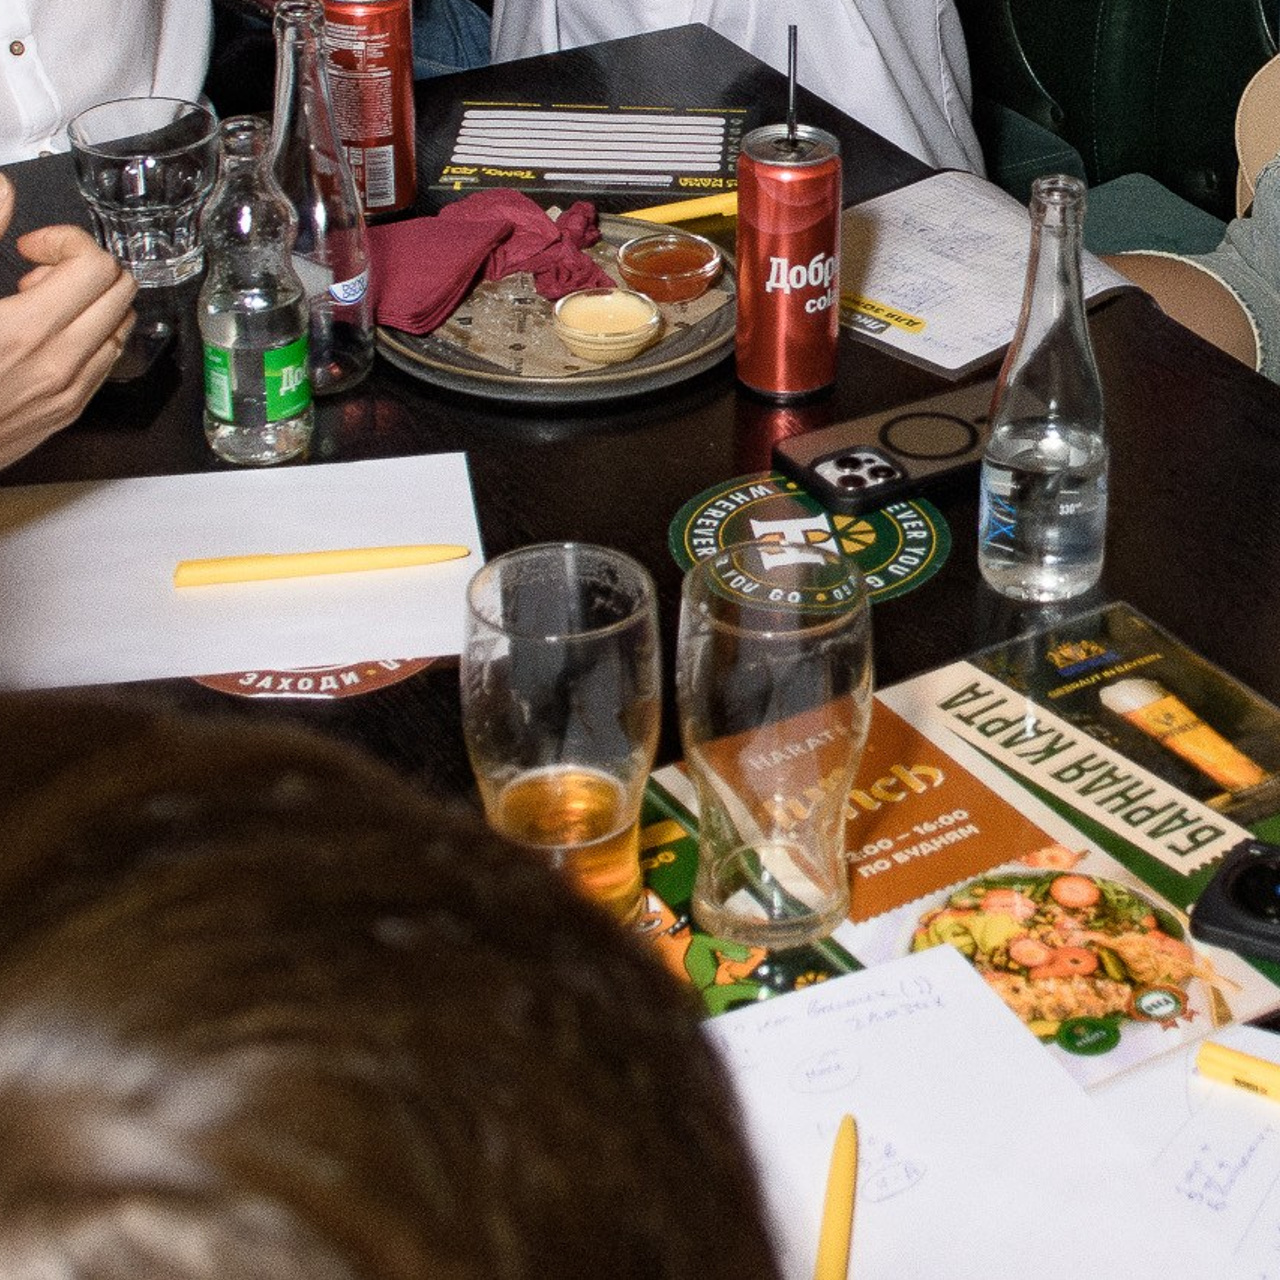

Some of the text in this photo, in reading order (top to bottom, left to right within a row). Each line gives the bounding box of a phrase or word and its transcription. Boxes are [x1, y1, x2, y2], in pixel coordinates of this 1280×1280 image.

[765, 252, 839, 295] Добр
[693, 485, 775, 558] WHEREVER
[887, 546, 927, 577] YOU
[238, 672, 361, 692] ЗАХОДИ
[936, 681, 1226, 857] БАРНАЯ КАРТА
[912, 808, 970, 835] 16:00
[857, 859, 893, 878] ПО
